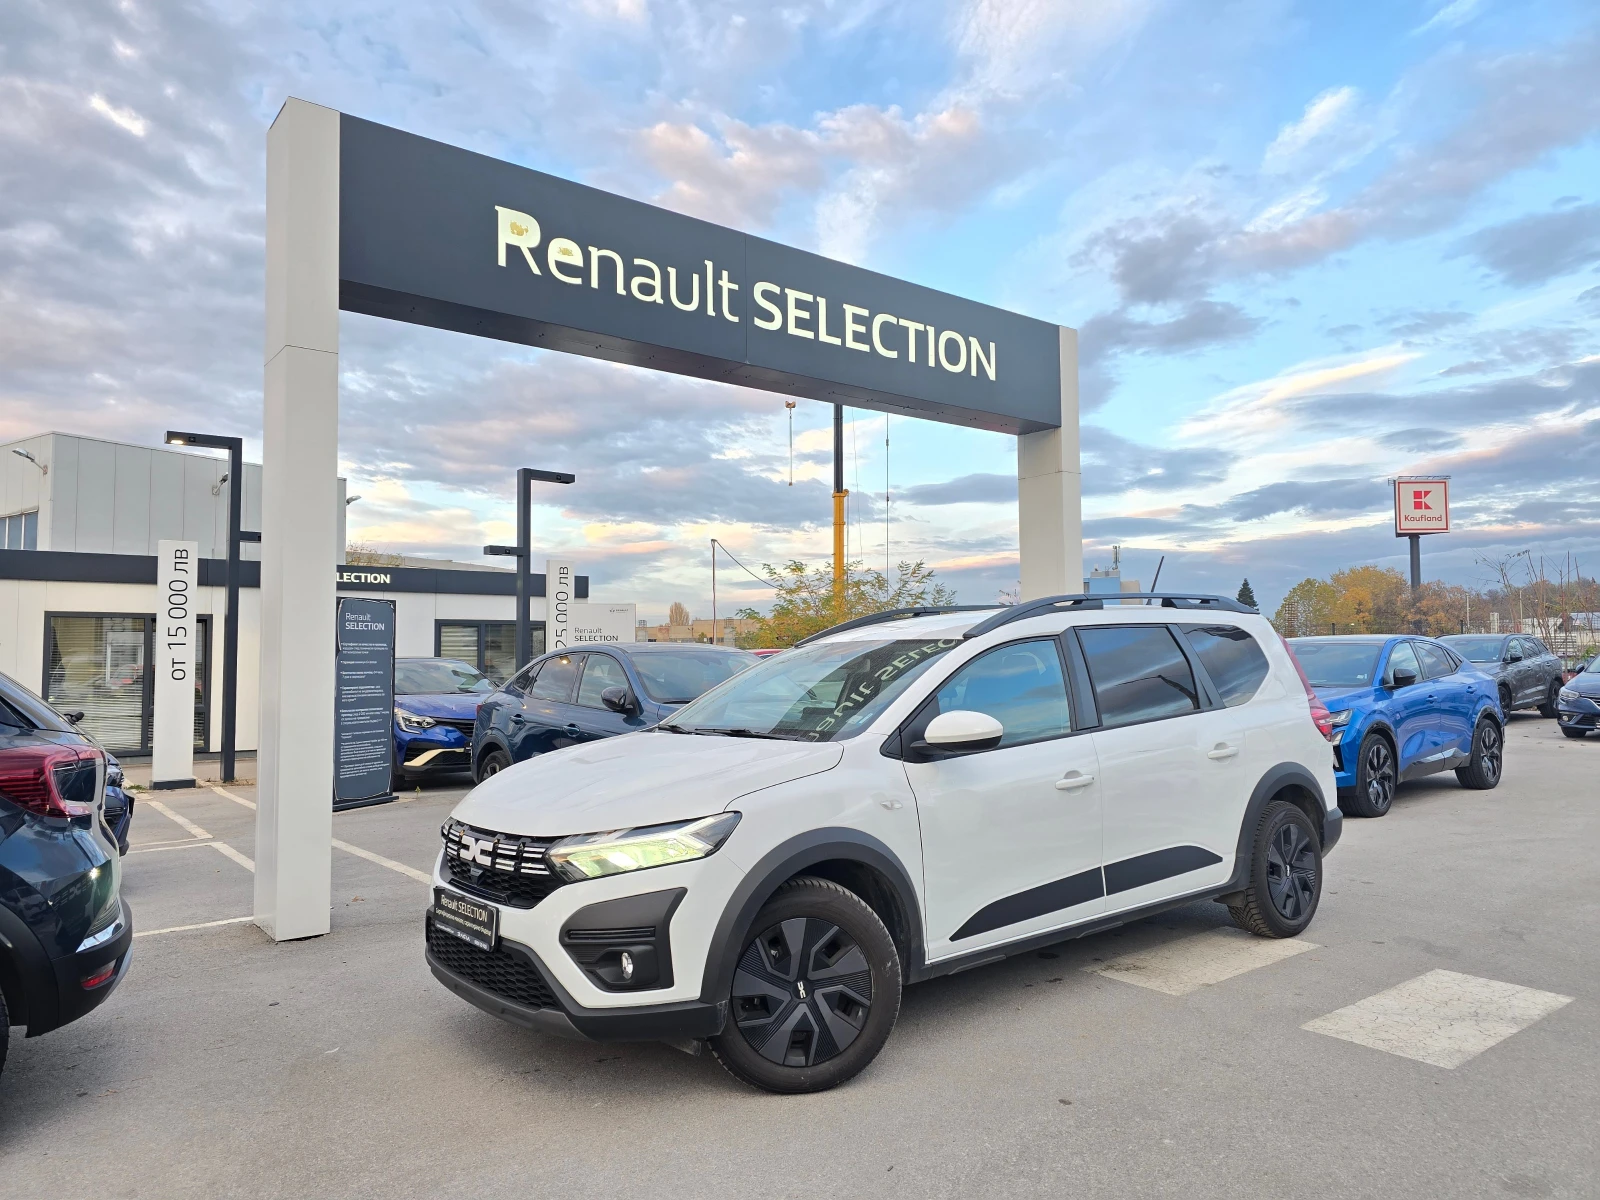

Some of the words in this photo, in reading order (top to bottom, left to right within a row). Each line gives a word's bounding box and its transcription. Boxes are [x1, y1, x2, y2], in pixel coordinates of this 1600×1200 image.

[495, 205, 740, 323] Renault
[753, 281, 996, 381] SELECTION
[1404, 514, 1442, 522] Kaufland
[168, 579, 188, 619] 000
[555, 591, 569, 623] 000
[345, 612, 371, 621] Renault
[345, 622, 385, 631] SELECTION
[167, 626, 187, 650] 15
[555, 628, 567, 648] 25
[441, 894, 458, 911] Renault
[458, 901, 488, 923] SELECTION
